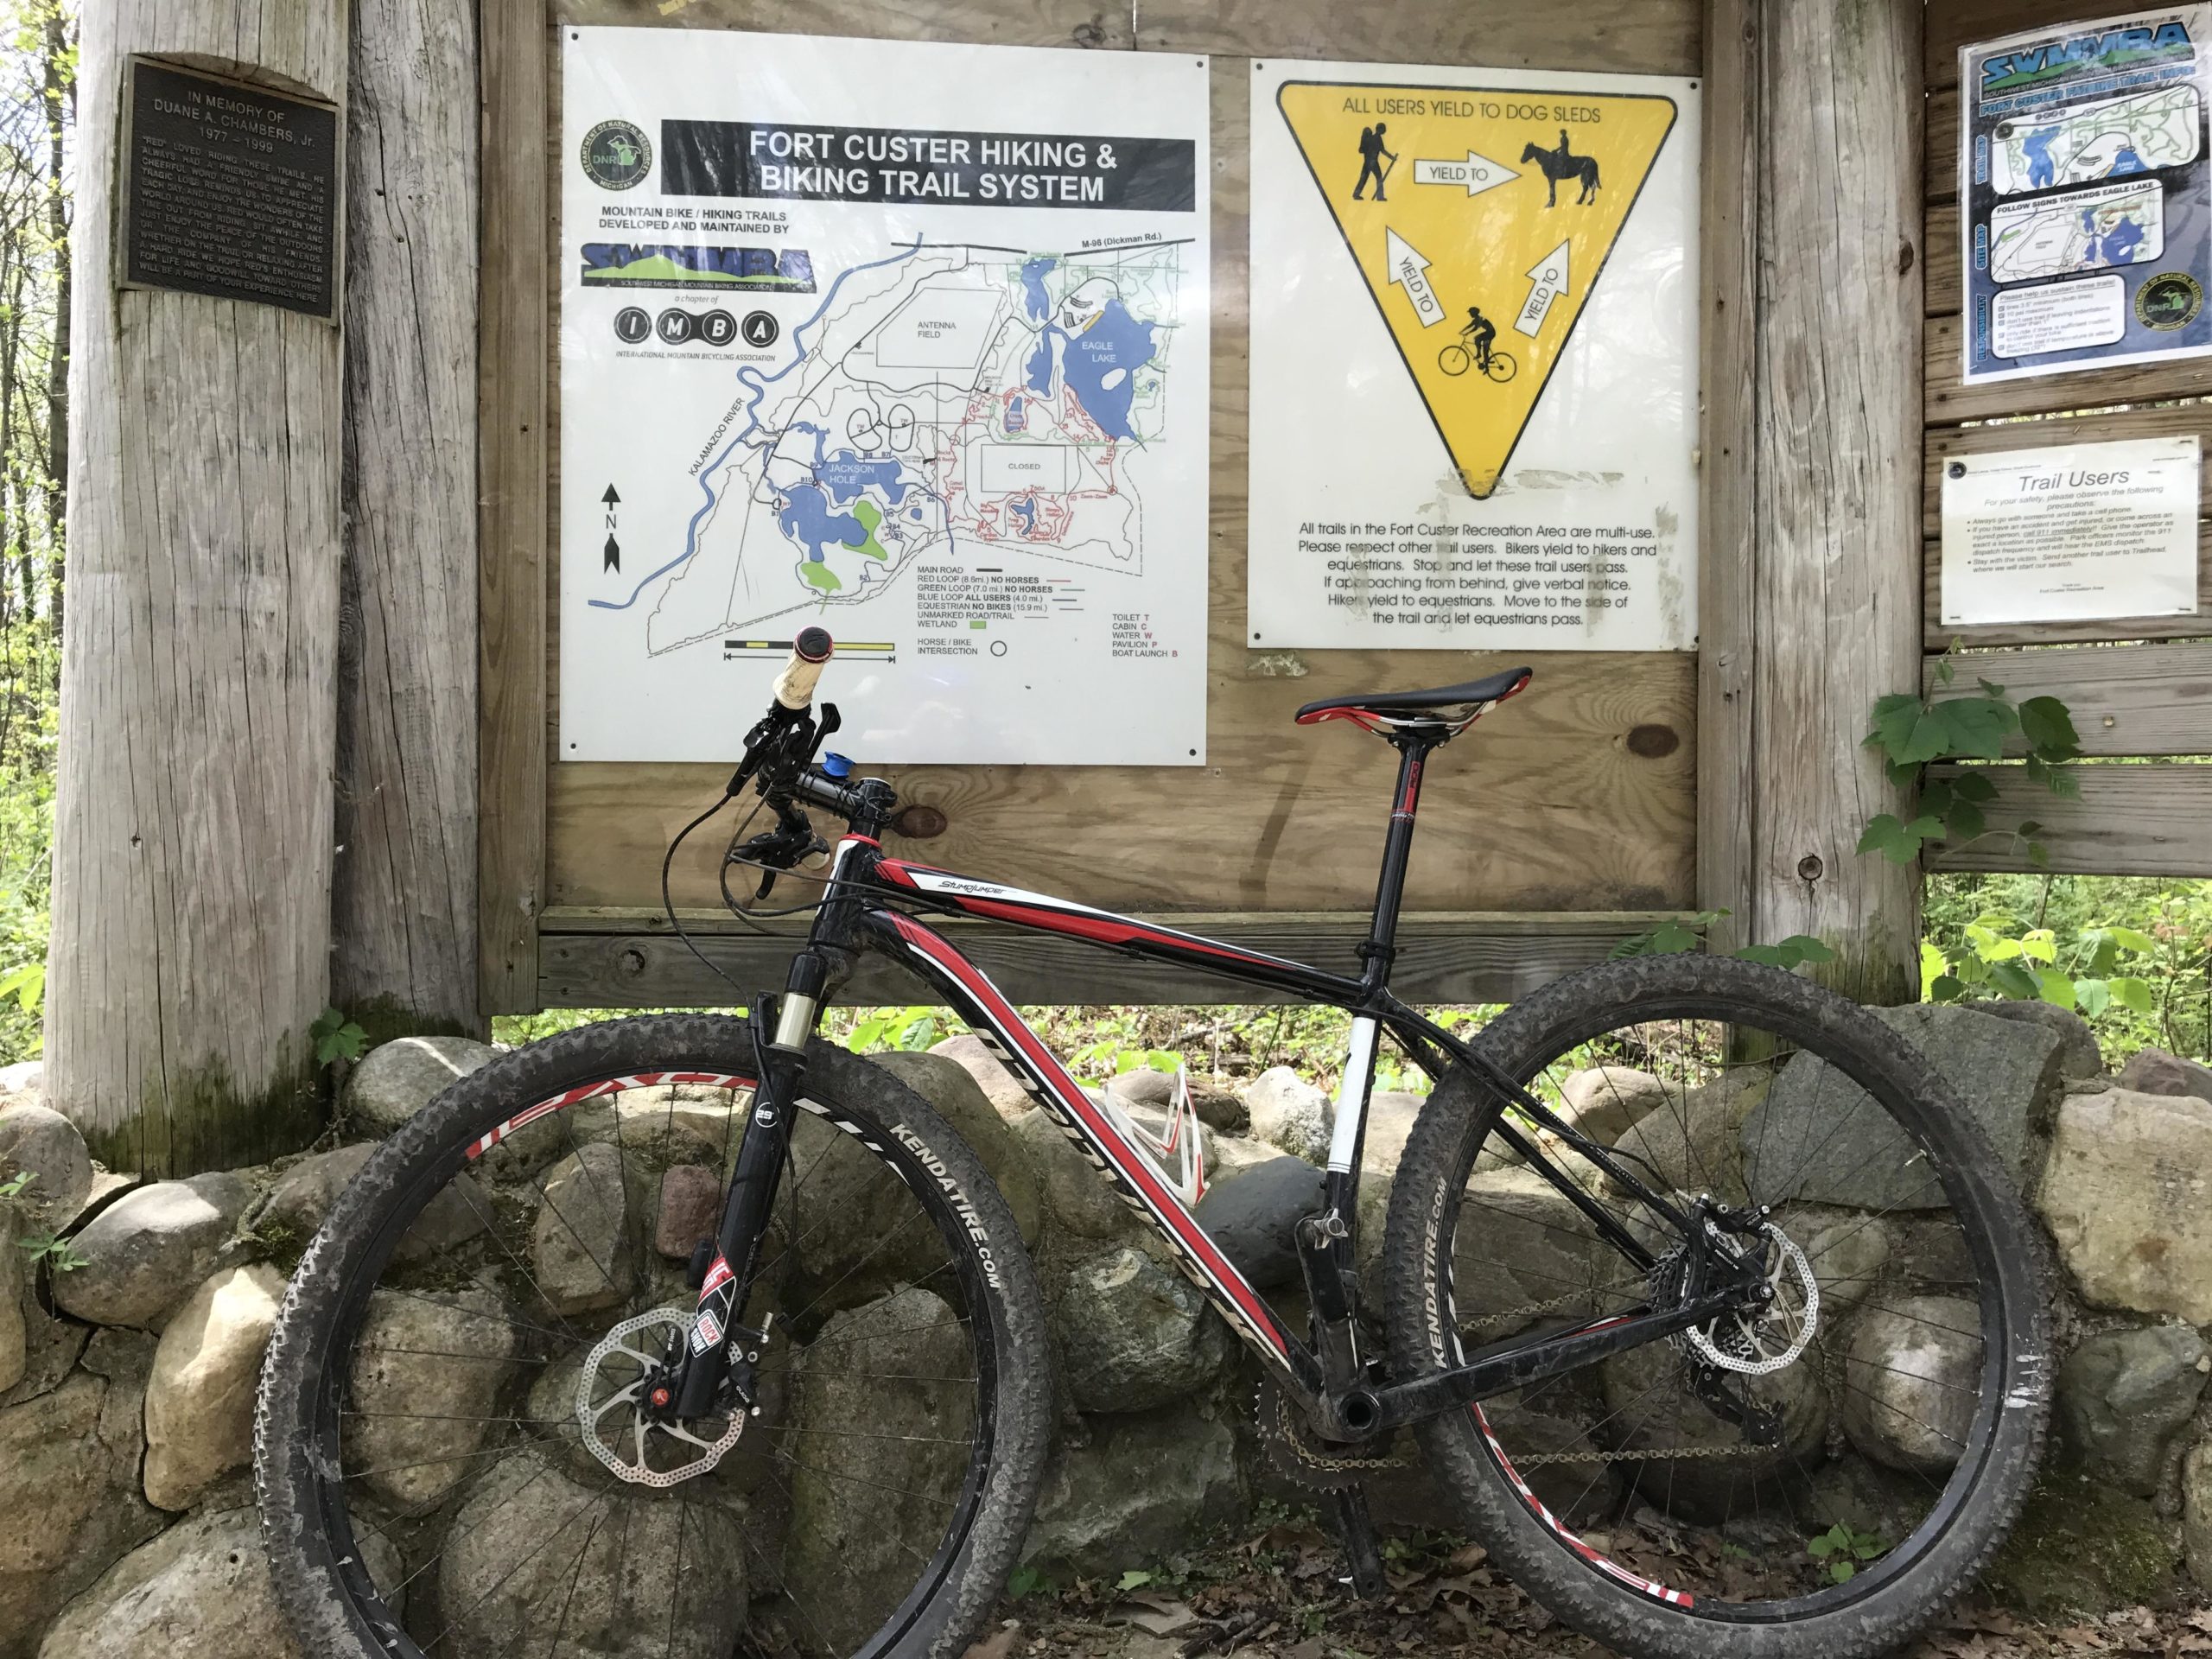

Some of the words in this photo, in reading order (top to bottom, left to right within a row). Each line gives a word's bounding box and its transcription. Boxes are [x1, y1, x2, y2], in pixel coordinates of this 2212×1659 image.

[1980, 101, 2012, 116] FORT
[2015, 90, 2063, 108] CUSTER
[2120, 72, 2158, 86] TRAIL
[188, 91, 201, 104] IN
[207, 94, 263, 118] MEMORY
[267, 110, 285, 123] OF
[1343, 97, 1371, 113] ALL
[1376, 99, 1426, 115] USERS
[1430, 100, 1474, 117] YIELD
[1479, 102, 1501, 118] TO
[1506, 104, 1548, 120] DOG
[1554, 105, 1601, 123] SLEDS
[154, 99, 200, 120] DUANE
[205, 111, 217, 124] A.
[221, 115, 296, 145] CHAMBERS,
[200, 127, 228, 143] 1977
[750, 130, 835, 161] FORT
[844, 135, 971, 162] CUSTER
[982, 140, 1086, 167] HIKING
[1096, 143, 1117, 168] &
[1976, 136, 1987, 156] MAP
[594, 156, 616, 164] DNR
[1430, 167, 1466, 181] YIELD
[1471, 168, 1489, 181] TO
[1976, 156, 1987, 184] TRAIL
[760, 165, 869, 196] BIKING
[879, 169, 970, 197] TRAIL
[979, 173, 1103, 200] SYSTEM
[1997, 202, 2031, 213] FOLLOW
[2031, 197, 2058, 207] SIGNS
[2059, 190, 2101, 203] TOWARDS
[2102, 186, 2130, 196] EAGLE
[2132, 181, 2154, 191] LAKE
[602, 206, 663, 216] MOUNTAIN
[666, 208, 693, 218] BIKE
[702, 209, 742, 219] HIKING
[745, 210, 786, 220] TRAILS
[599, 219, 670, 229] DEVELOPED
[671, 221, 696, 231] AND
[700, 222, 771, 232] MAINTAINED
[773, 224, 789, 233] BY
[1976, 225, 1987, 246] MAP
[1976, 247, 1987, 269] SITE
[1399, 257, 1423, 293] YIELD
[1417, 294, 1433, 313] TO
[1525, 287, 1548, 321] YIELD
[1542, 268, 1559, 286] TO
[918, 321, 957, 330] ANTENNA
[1976, 295, 1987, 359] RESPONSIBILITY
[1082, 341, 1114, 351] EAGLE
[1092, 354, 1116, 363] LAKE
[689, 424, 726, 476] KALAMAZOO
[723, 397, 745, 425] RIVER
[829, 465, 874, 474] JACKSON
[830, 475, 856, 484] HOLE
[2018, 473, 2063, 492] Trail
[2069, 471, 2130, 487] Users
[1984, 499, 1999, 507] For
[1999, 497, 2018, 506] your
[2047, 493, 2075, 502] please
[2075, 490, 2110, 499] observe
[2126, 486, 2164, 495] following
[607, 514, 616, 529] N
[1300, 522, 1314, 534] All
[1318, 523, 1346, 534] trails
[1351, 523, 1361, 534] in
[1364, 523, 1387, 535] the
[1390, 523, 1414, 535] Fort
[1417, 523, 1459, 535] Custer
[1463, 524, 1533, 536] Recreation
[1535, 524, 1567, 537] Area
[1570, 527, 1592, 537] are
[1595, 526, 1655, 538] multi-use.
[1299, 540, 1342, 552] Please
[1398, 541, 1433, 553] other
[1462, 543, 1497, 553] users.
[1506, 542, 1540, 554] Bikers
[1542, 543, 1573, 556] yield
[1576, 543, 1590, 555] to
[1593, 543, 1628, 556] hikers
[1630, 544, 1657, 556] and
[1327, 559, 1404, 571] equestrians.
[1414, 558, 1442, 572] Stop
[1446, 560, 1472, 571] and
[1477, 559, 1492, 571] let
[1496, 560, 1531, 571] these
[1535, 560, 1557, 572] trail
[1560, 563, 1592, 572] users
[1595, 563, 1628, 574] pass.
[918, 575, 935, 583] RED
[937, 575, 959, 583] LOOP
[991, 575, 1003, 584] NO
[1005, 575, 1039, 584] HORSES
[1325, 575, 1332, 588] If
[1426, 576, 1456, 588] from
[1459, 577, 1508, 589] behind,
[1513, 578, 1541, 592] give
[1544, 578, 1584, 589] verbal
[1588, 579, 1631, 590] notice.
[918, 583, 946, 592] GREEN
[949, 583, 971, 592] LOOP
[1005, 584, 1017, 593] NO
[1019, 584, 1052, 593] HORSES
[918, 593, 938, 601] BLUE
[941, 593, 963, 601] LOOP
[965, 594, 982, 602] ALL
[983, 594, 1011, 602] USERS
[1367, 594, 1398, 607] yield
[1402, 594, 1415, 606] to
[1419, 594, 1495, 607] equestrians.
[1504, 594, 1541, 607] Move
[1544, 595, 1557, 607] to
[1560, 595, 1582, 607] the
[1615, 596, 1628, 607] of
[918, 601, 970, 610] EQUESTRIAN
[972, 602, 985, 611] NO
[987, 602, 1011, 611] BIKES
[918, 611, 964, 620] UNMARKED
[1372, 612, 1395, 623] the
[1397, 612, 1421, 623] trail
[1424, 613, 1452, 624] and
[1454, 612, 1470, 624] let
[1474, 612, 1548, 626] equestrians
[1551, 615, 1583, 626] pass.
[917, 620, 957, 628] WETLAND
[1112, 622, 1137, 631] CABIN
[918, 638, 947, 646] HORSE
[918, 646, 978, 655] INTERSECTION
[889, 1123, 1001, 1288] KENDATIRE.COM
[1424, 1176, 1448, 1370] KENDATIRE.COM
[699, 1318, 719, 1344] ROCK
